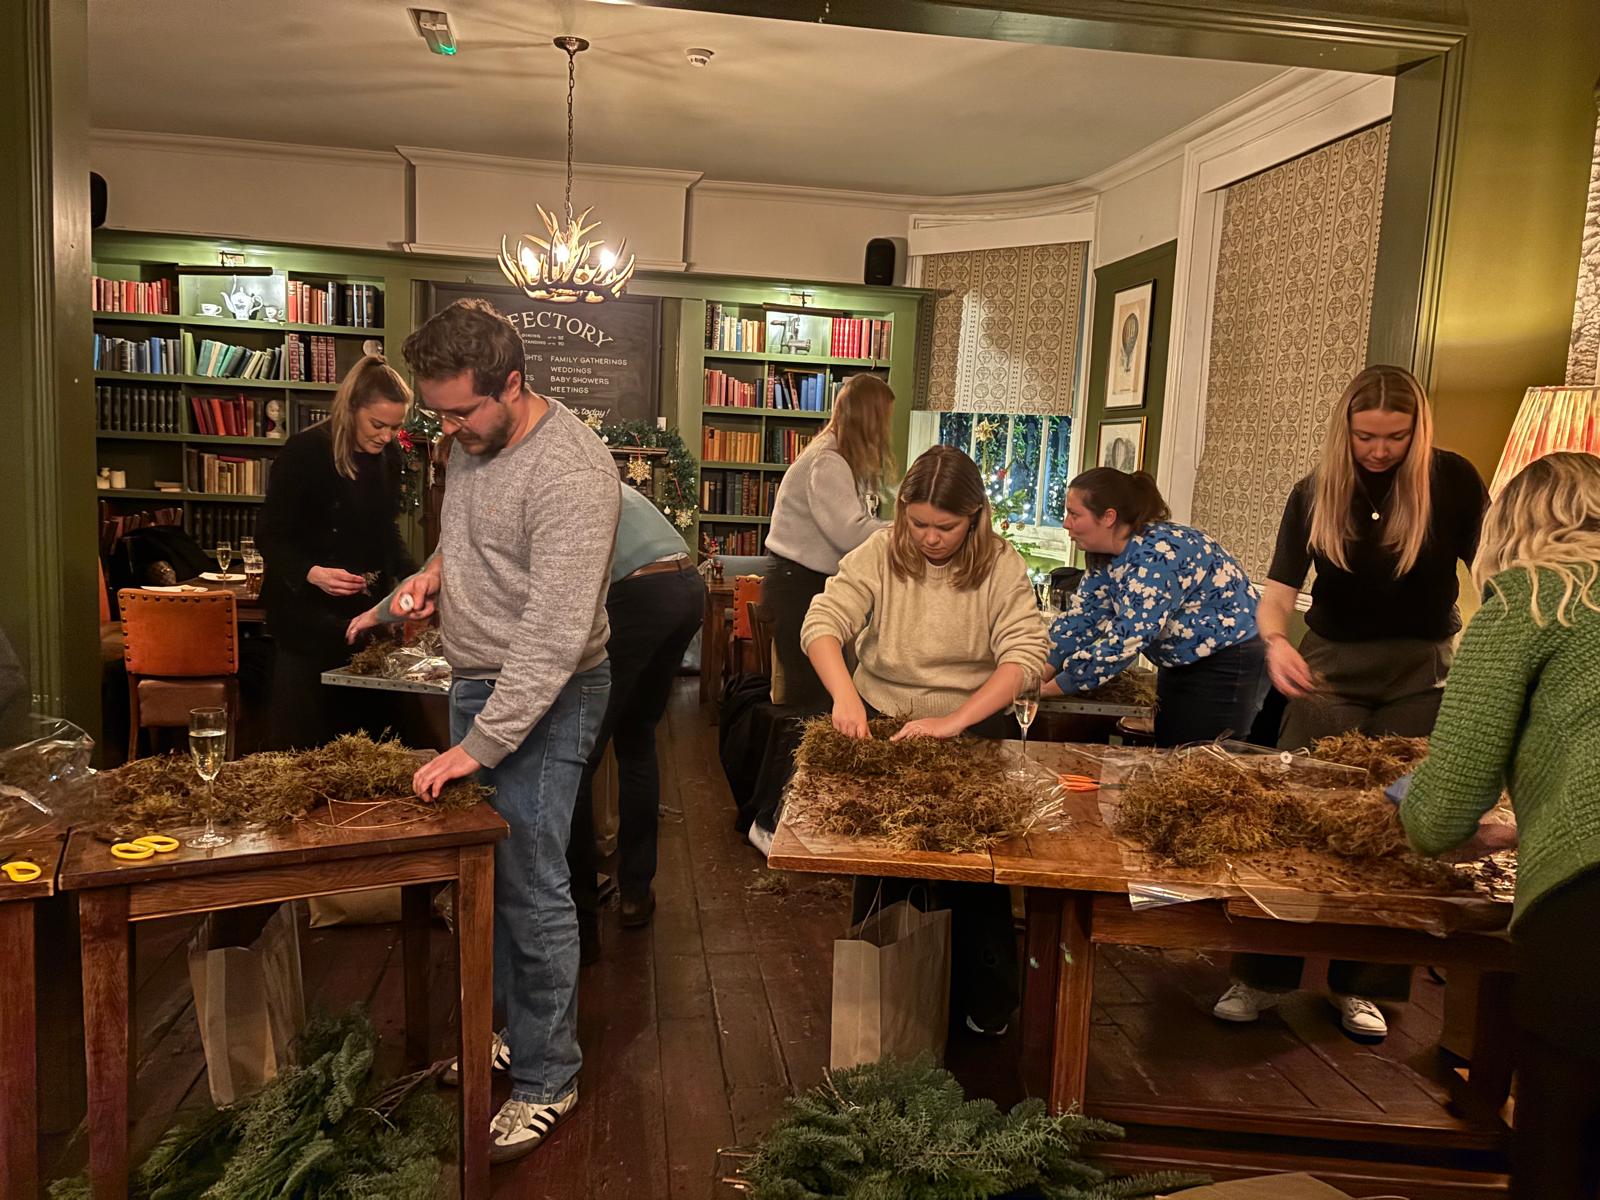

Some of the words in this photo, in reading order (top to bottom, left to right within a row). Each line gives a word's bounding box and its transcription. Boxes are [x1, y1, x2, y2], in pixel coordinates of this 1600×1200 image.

[550, 355, 578, 364] FAMILY
[580, 357, 628, 366] GATHERINGS
[550, 366, 592, 374] WEDDINGS
[550, 375, 571, 383] BABY
[572, 376, 609, 385] SHOWERS
[550, 386, 589, 394] MEETINGS
[581, 407, 611, 418] today!
